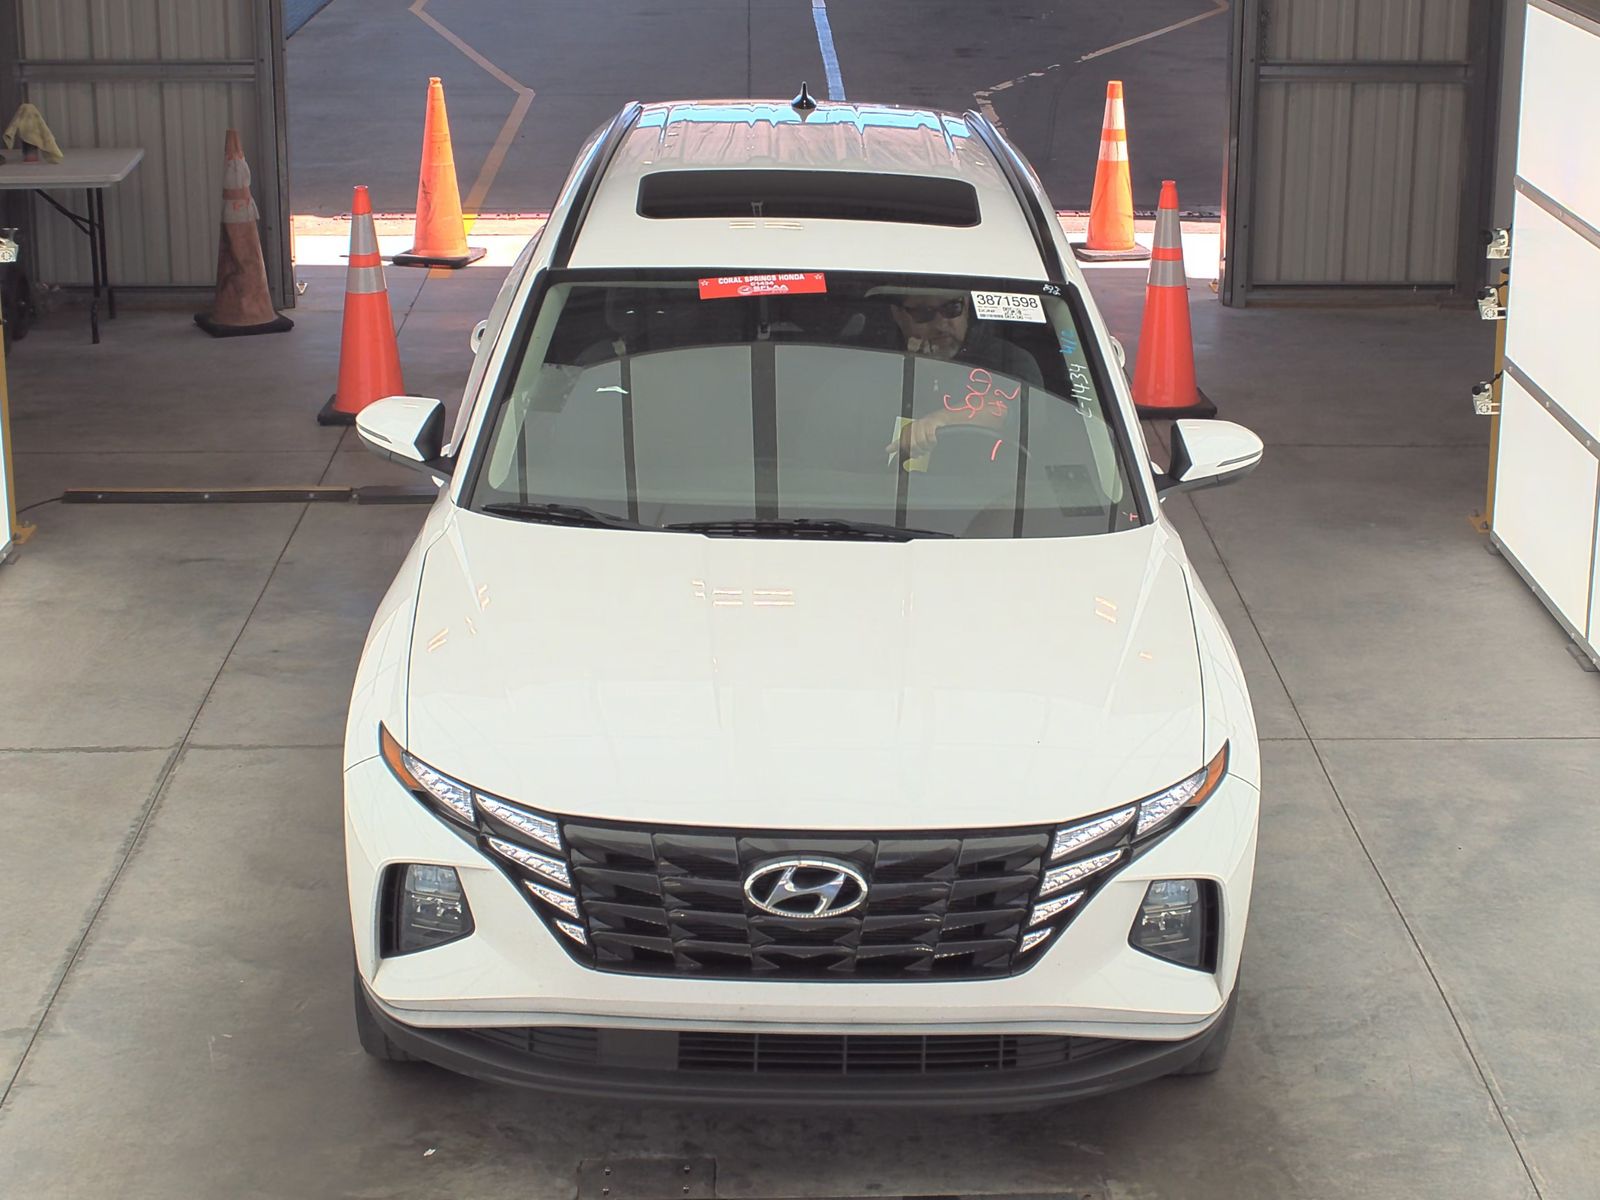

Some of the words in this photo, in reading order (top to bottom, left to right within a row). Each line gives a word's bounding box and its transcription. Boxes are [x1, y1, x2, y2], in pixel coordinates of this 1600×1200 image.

[718, 277, 743, 285] CORAL
[744, 275, 777, 283] SPRINGS
[778, 273, 805, 281] HONDA
[976, 294, 1038, 309] 3871598
